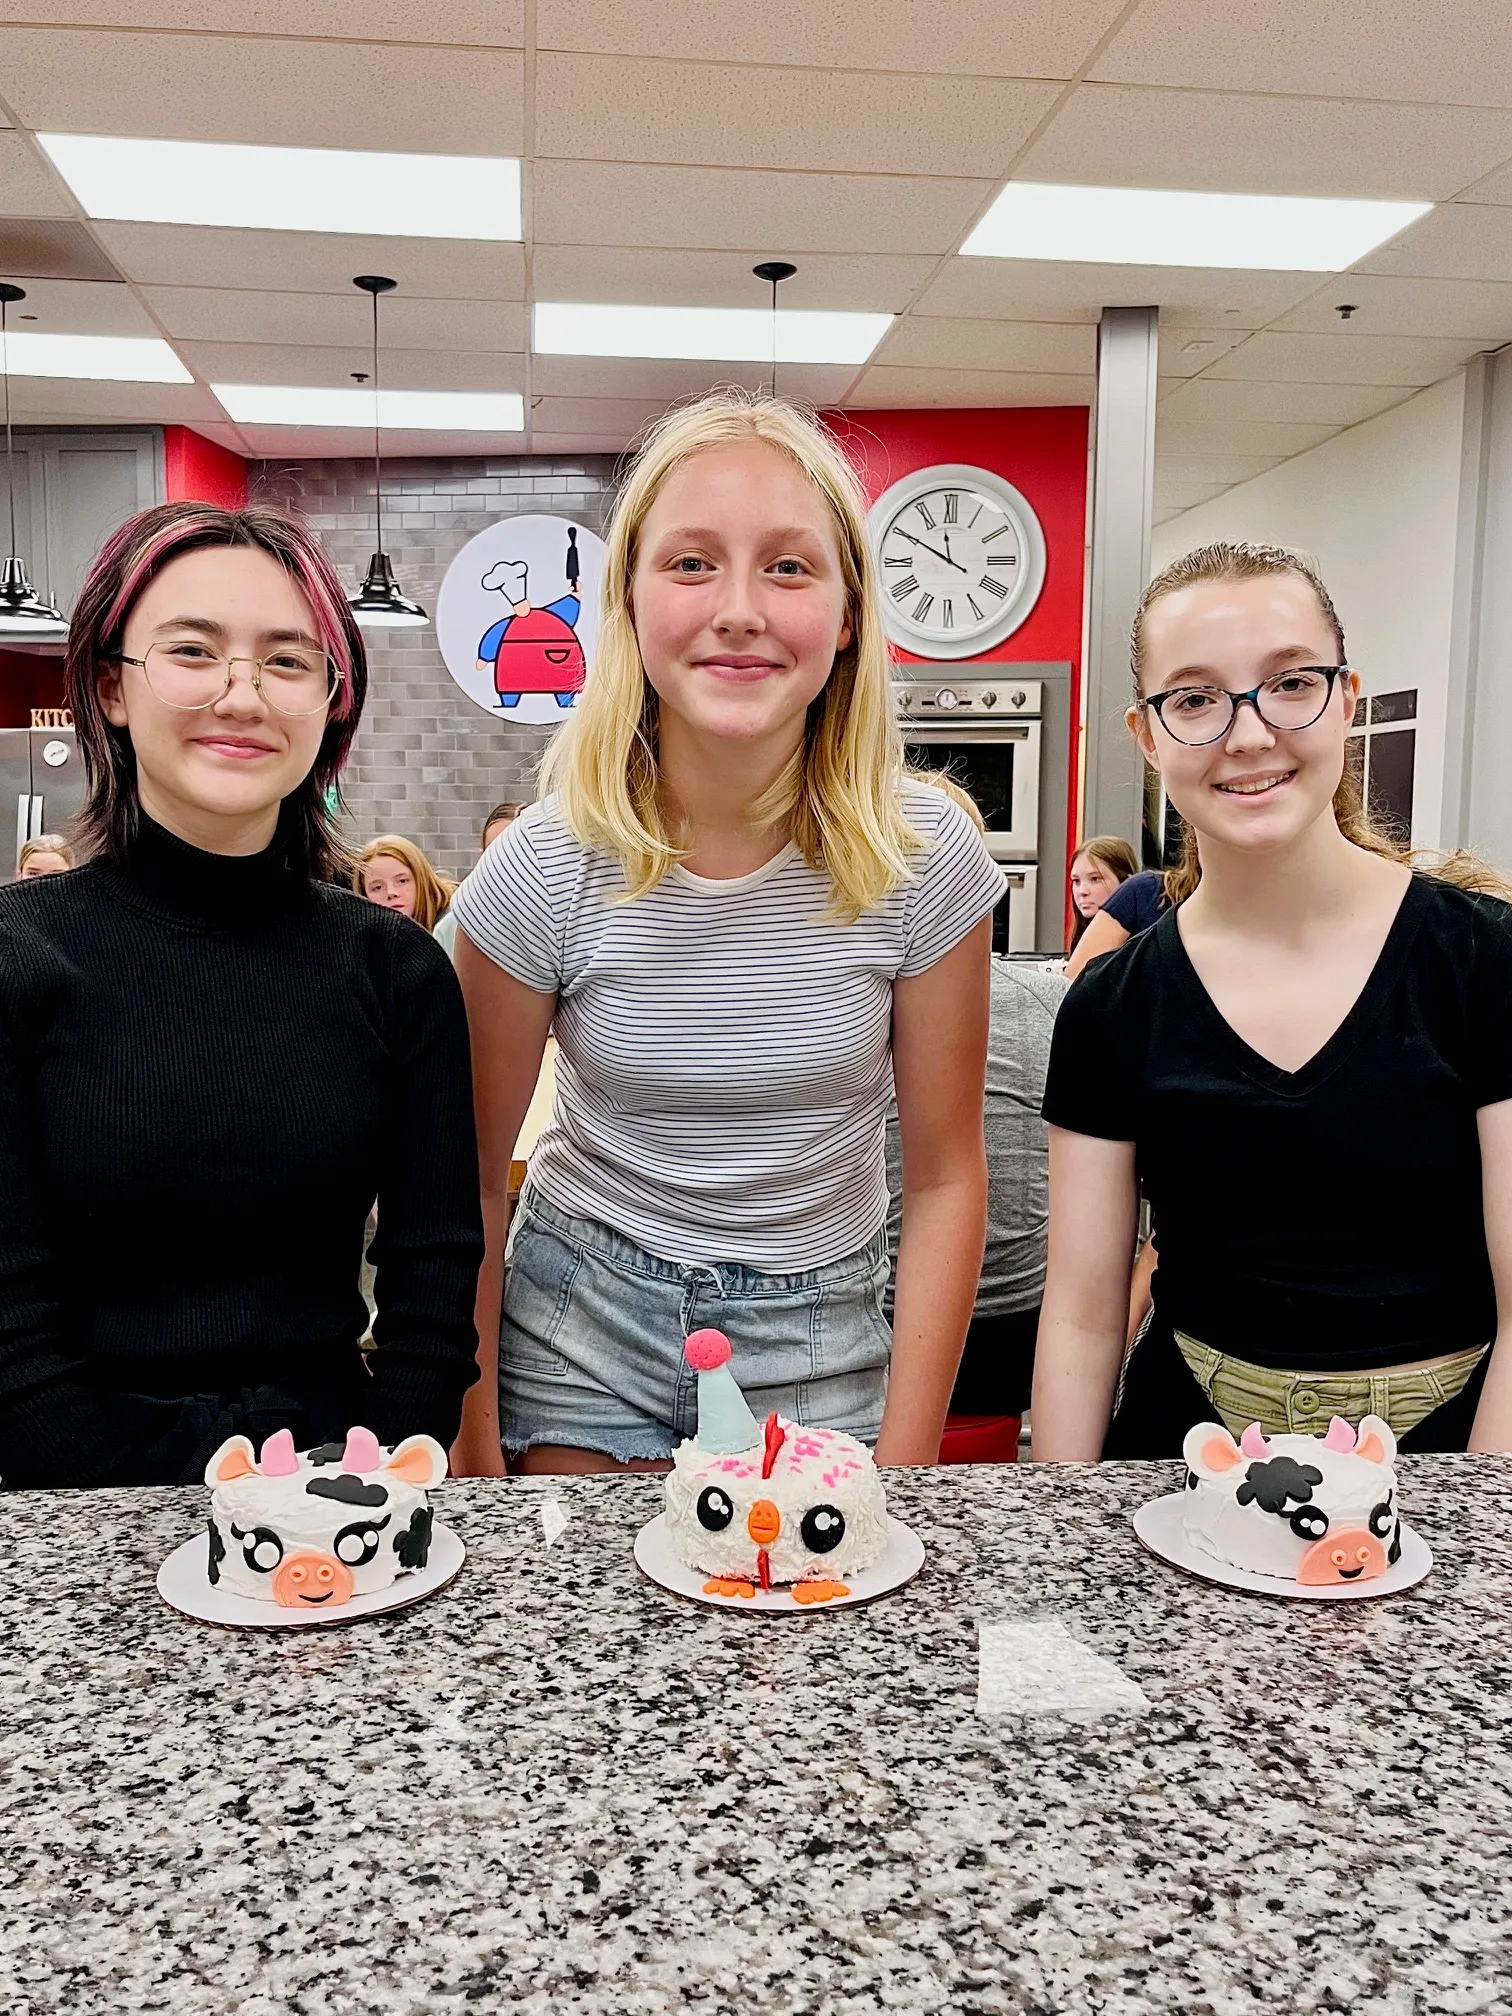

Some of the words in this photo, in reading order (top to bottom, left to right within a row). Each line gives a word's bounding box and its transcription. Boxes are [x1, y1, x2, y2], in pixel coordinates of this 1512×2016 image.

[914, 501, 937, 531] XI
[943, 494, 959, 523] XII
[981, 525, 1009, 544] II
[884, 557, 913, 568] IX
[987, 556, 1016, 566] III
[890, 574, 920, 603] VIII
[911, 591, 935, 622] VII
[942, 599, 954, 628] VI
[966, 593, 985, 621] V
